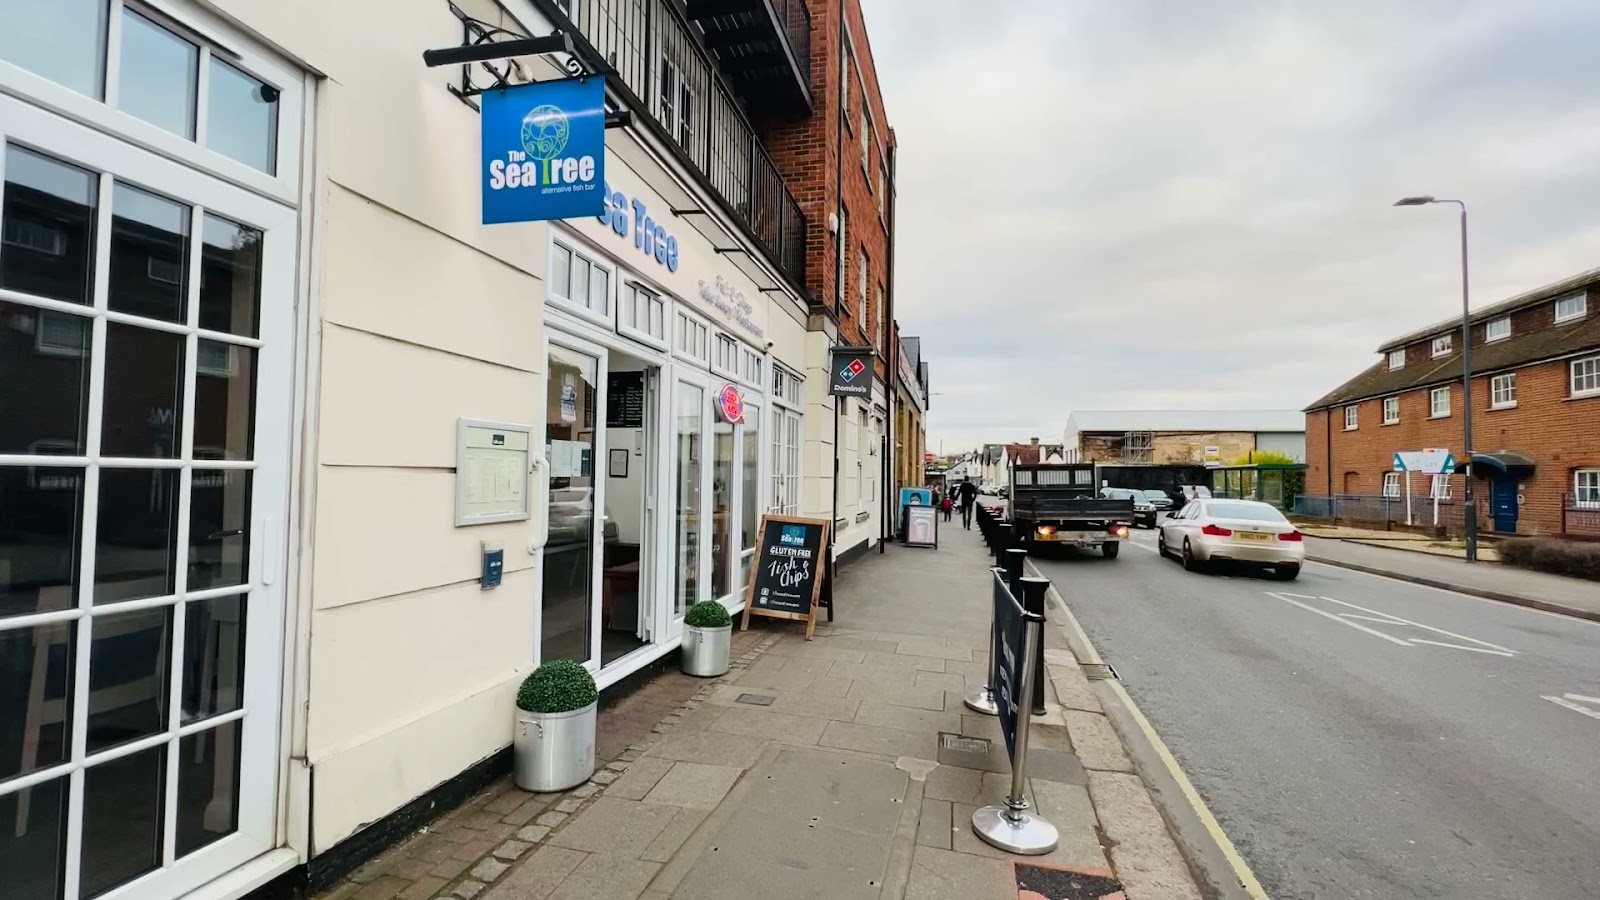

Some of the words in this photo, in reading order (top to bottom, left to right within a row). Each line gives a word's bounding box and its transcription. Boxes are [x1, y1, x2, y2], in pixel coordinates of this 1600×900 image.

[508, 150, 526, 162] The
[489, 159, 537, 190] Sea
[542, 155, 595, 185] Tree
[541, 184, 572, 195] alternative
[572, 184, 584, 192] fish
[585, 183, 596, 191] bar
[597, 181, 628, 238] ea
[632, 197, 678, 274] Tree
[834, 384, 867, 393] Domino's
[769, 545, 797, 557] GLUTEN
[797, 548, 812, 559] FREE
